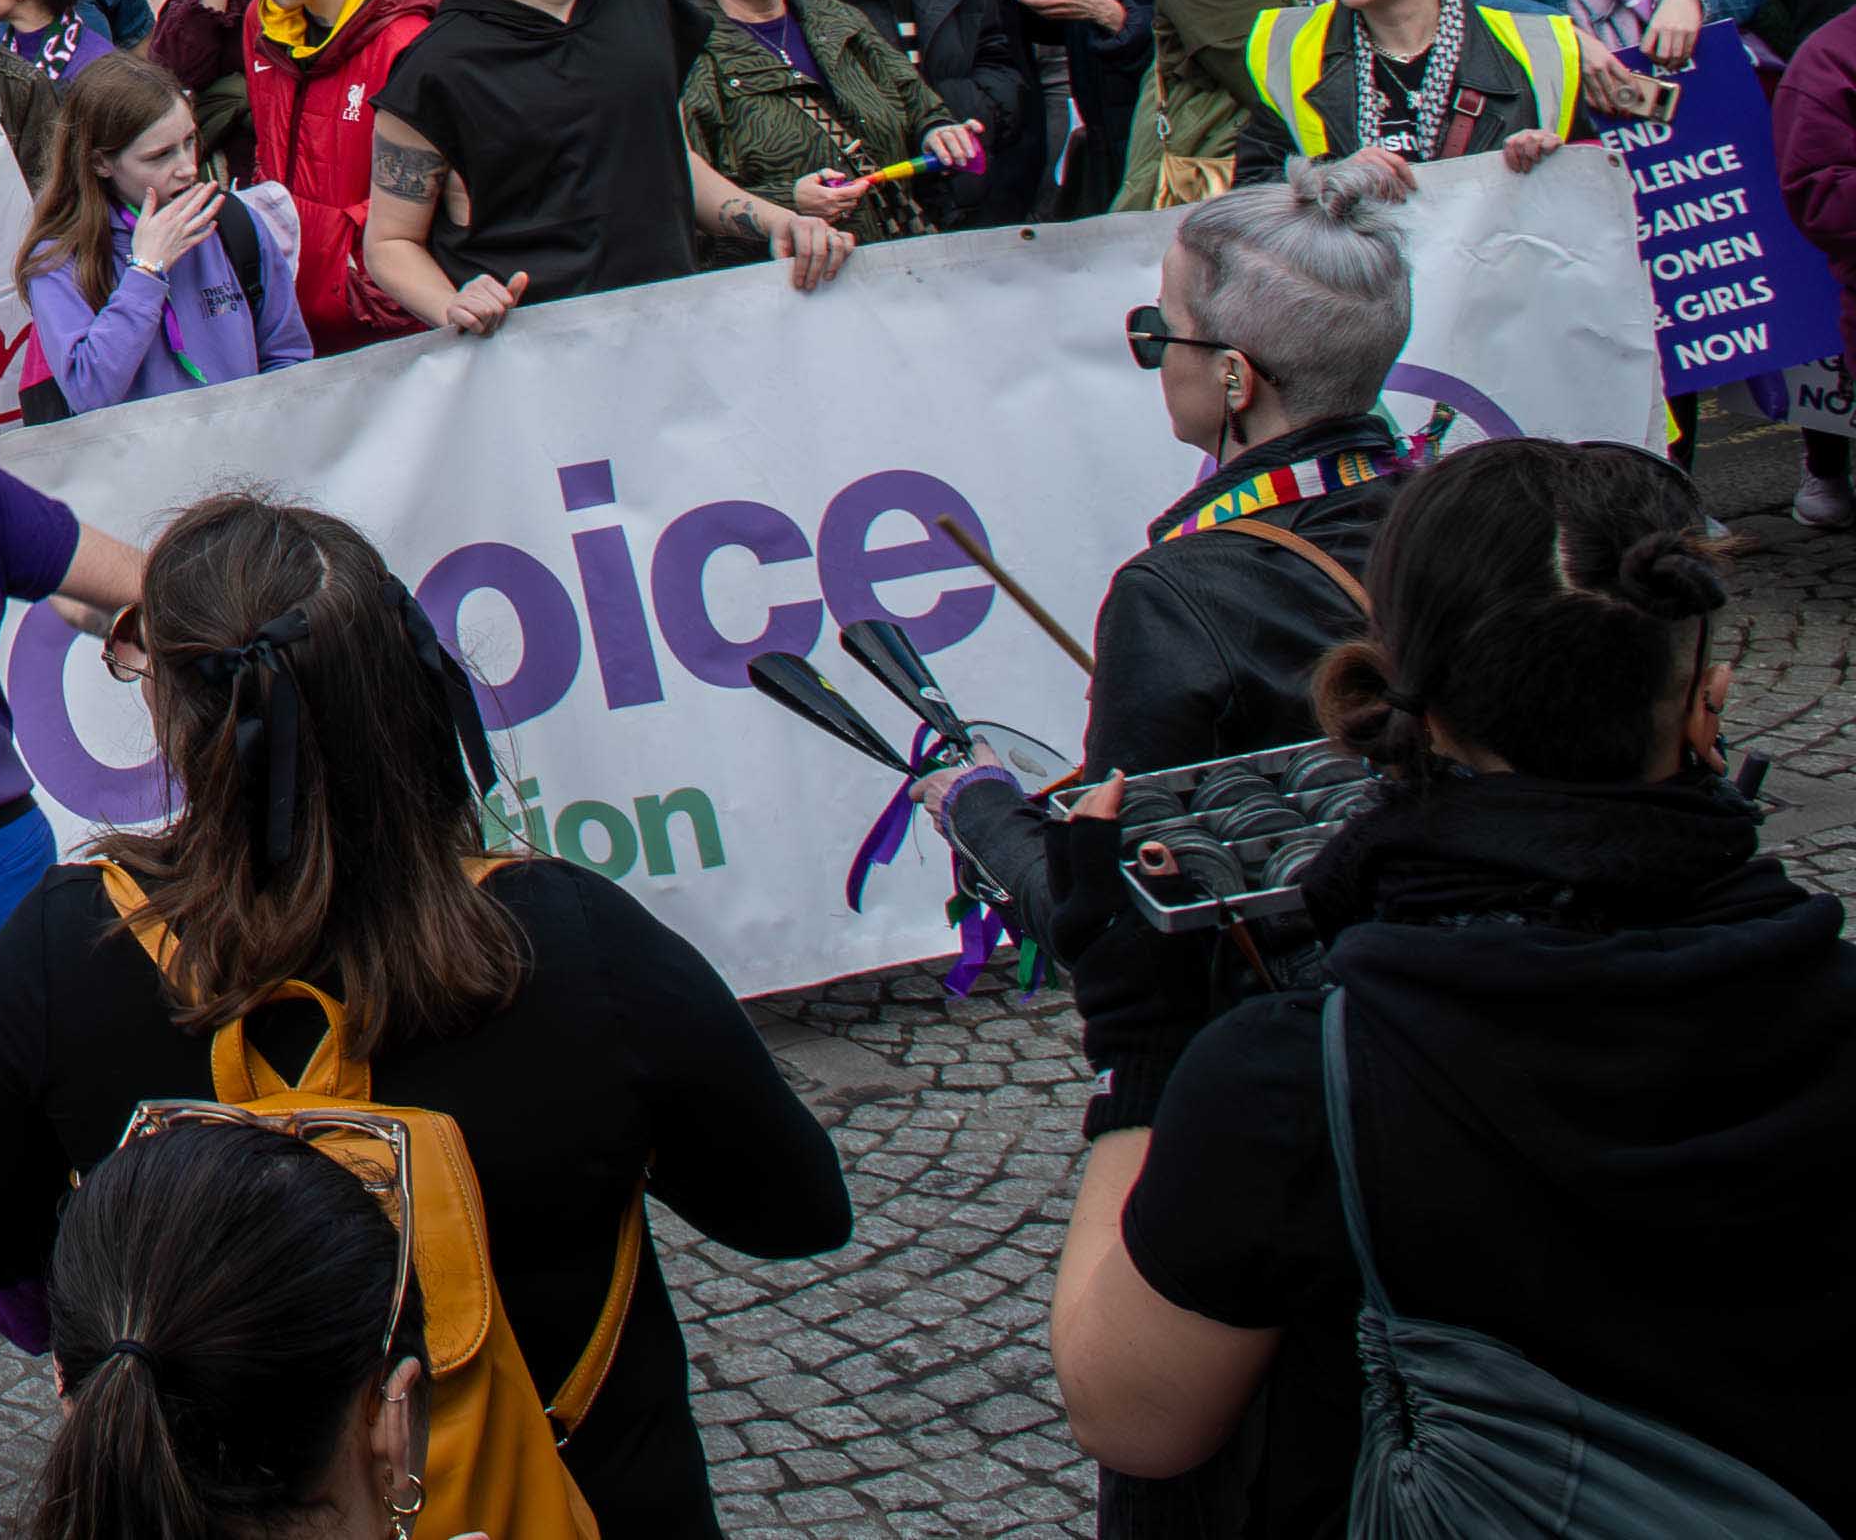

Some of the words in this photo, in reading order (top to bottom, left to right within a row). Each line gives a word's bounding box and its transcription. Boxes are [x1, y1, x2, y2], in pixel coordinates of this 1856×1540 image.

[1600, 121, 1674, 154] END
[1632, 143, 1744, 195] LENCE
[1636, 187, 1750, 241] GAINST
[1644, 231, 1765, 283] OMEN
[1674, 275, 1776, 324] GIRLS
[1673, 321, 1771, 371] NOW
[7, 458, 997, 827] Coice
[485, 777, 727, 884] tion
